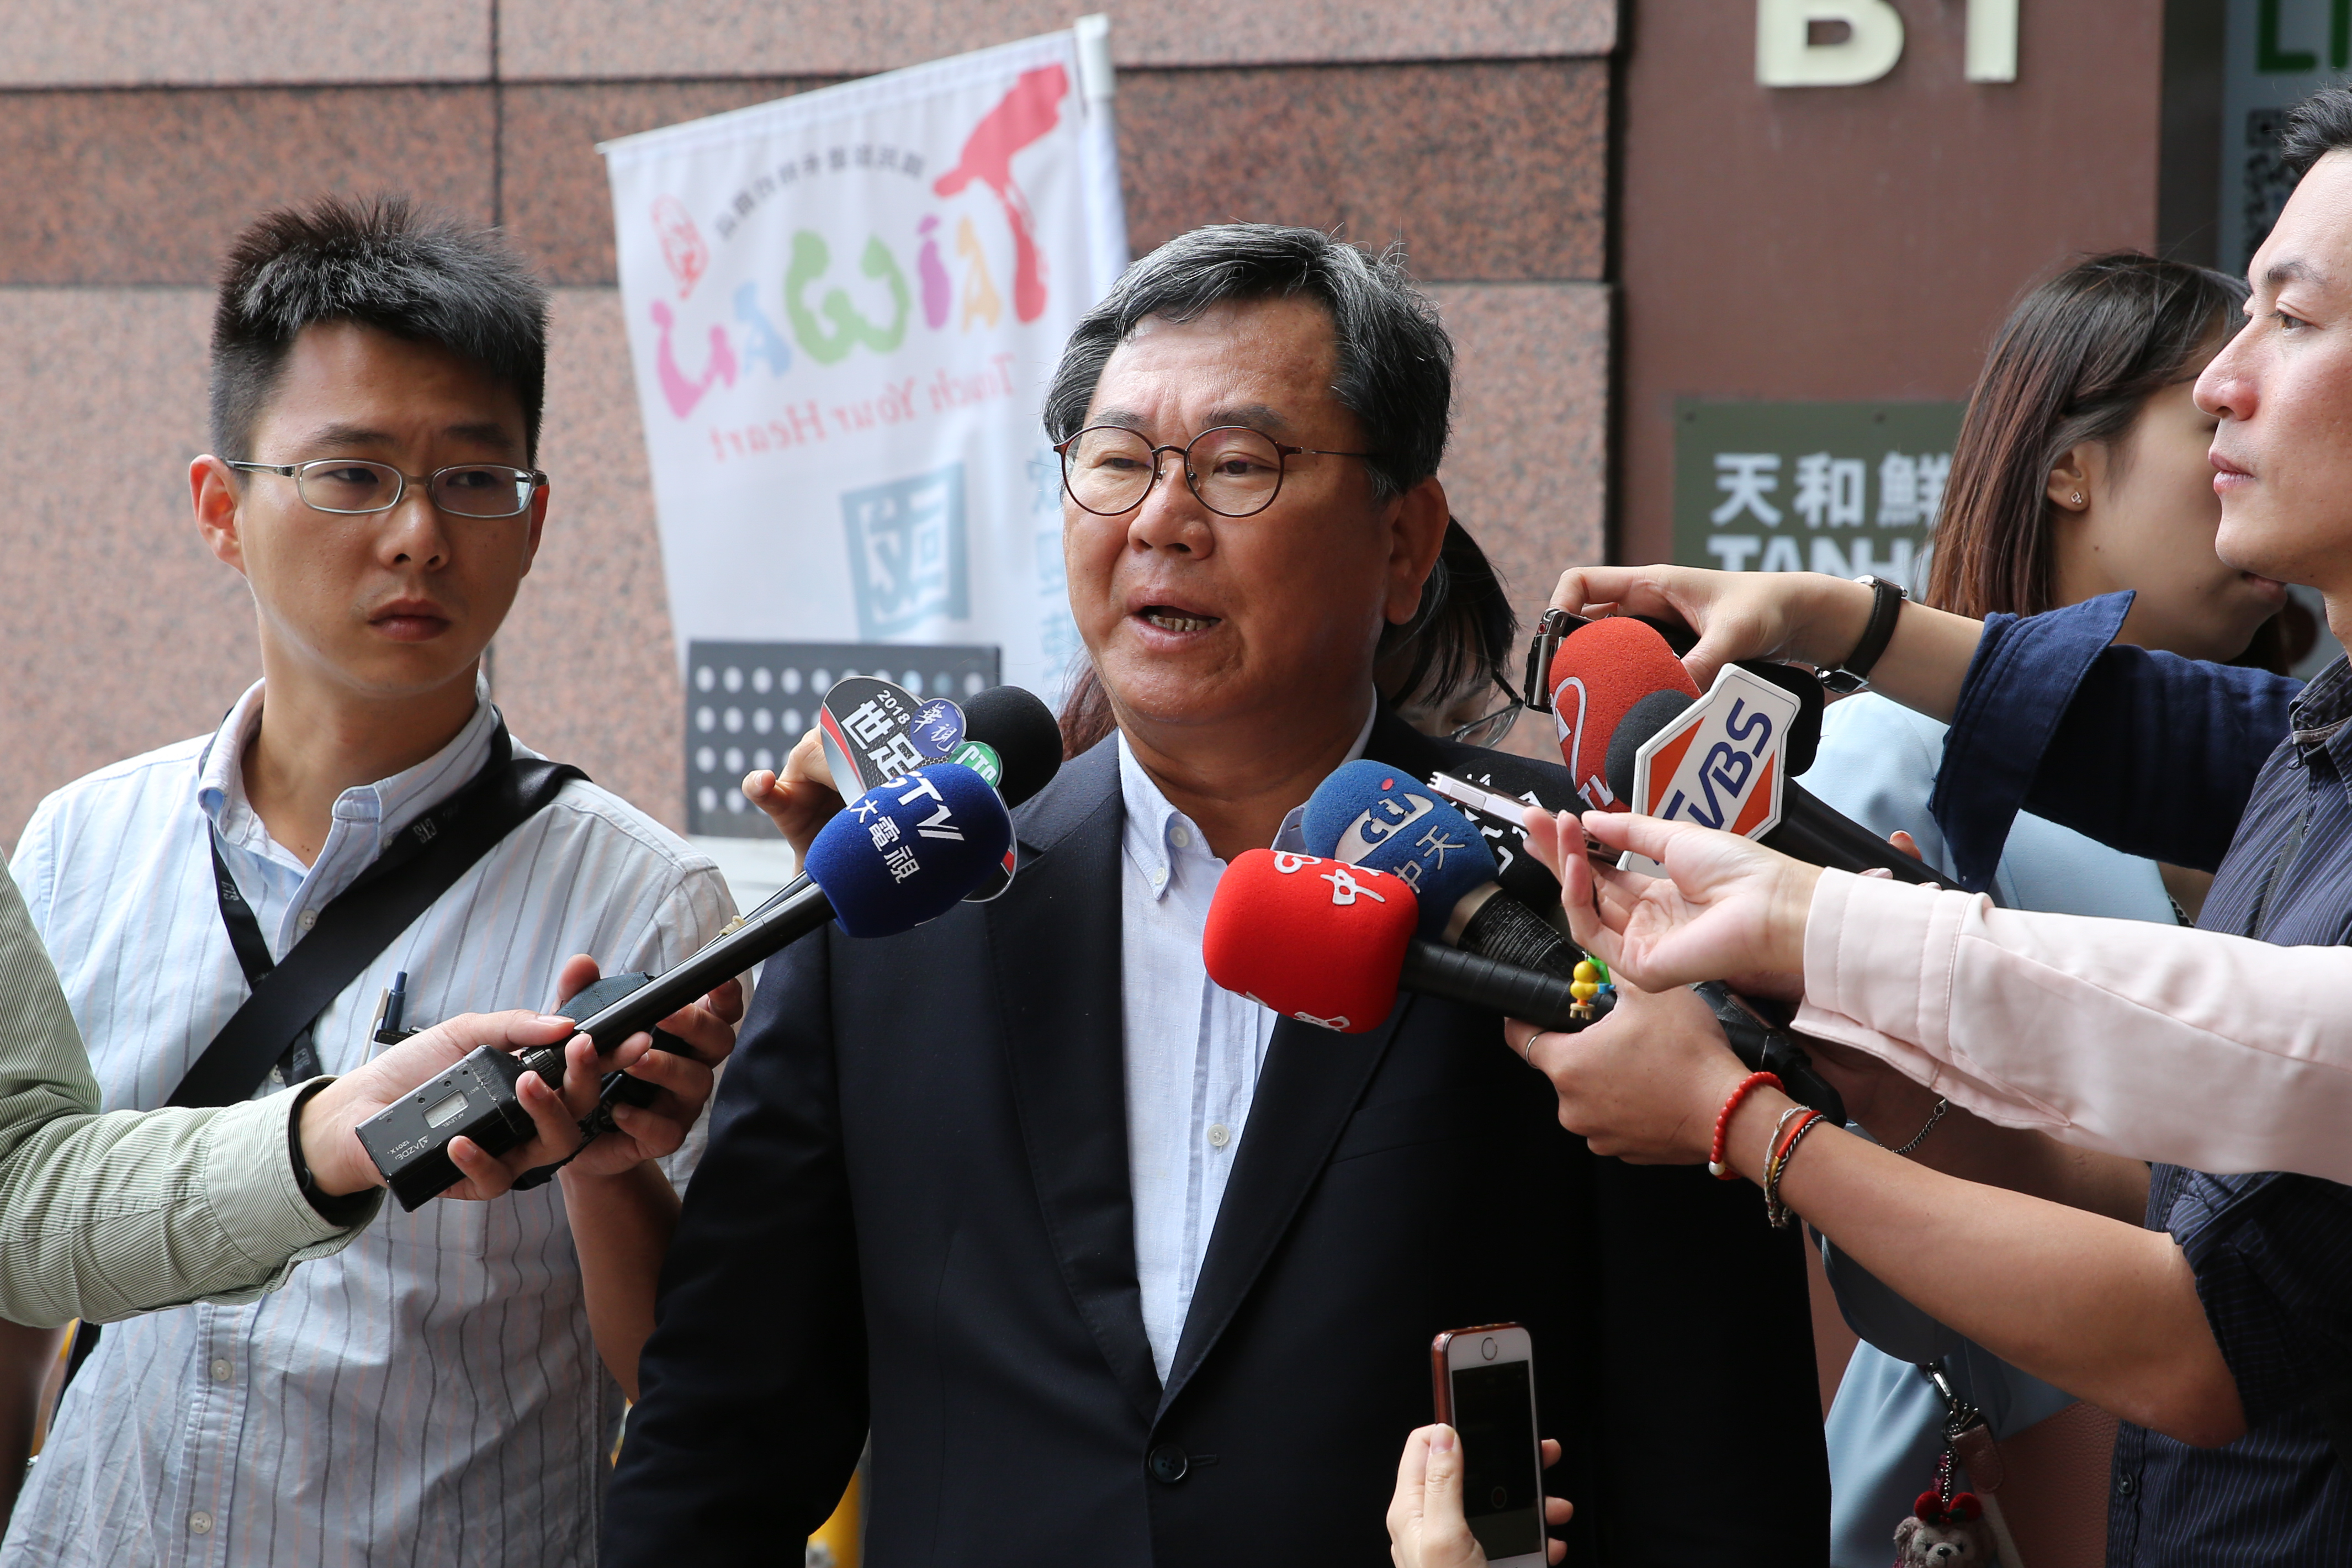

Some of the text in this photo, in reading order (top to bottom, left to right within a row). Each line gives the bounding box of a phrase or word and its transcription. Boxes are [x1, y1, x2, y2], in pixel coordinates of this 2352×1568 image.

[1705, 534, 1932, 599] TANH
[876, 689, 910, 725] 2018
[913, 702, 958, 752] 華視
[1393, 824, 1466, 894] 中天
[442, 1116, 457, 1129] LEVEL
